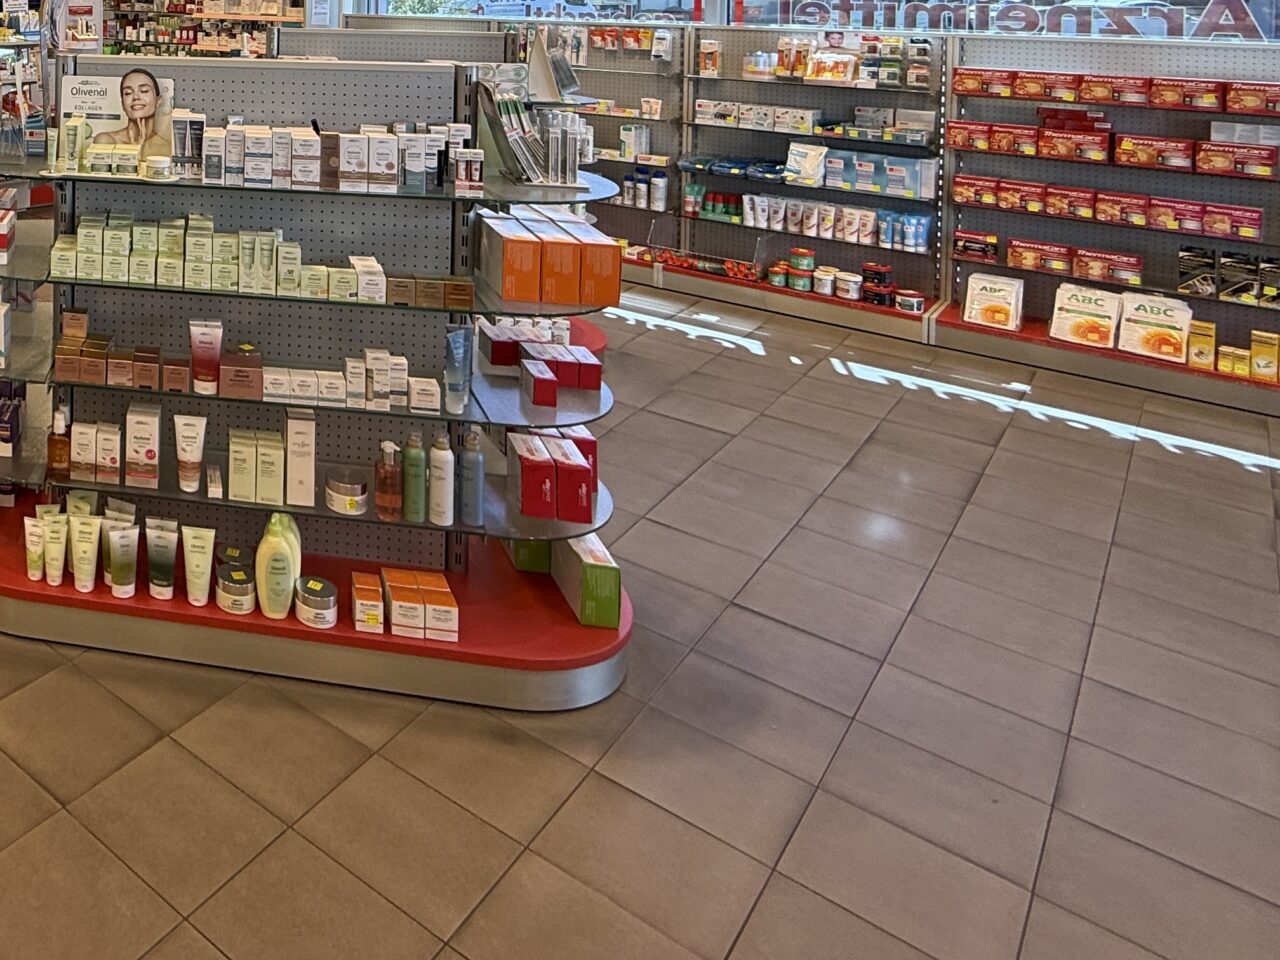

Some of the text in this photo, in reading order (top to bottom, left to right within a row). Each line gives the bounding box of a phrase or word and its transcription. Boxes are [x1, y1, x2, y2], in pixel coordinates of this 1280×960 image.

[70, 86, 108, 97] Olivenöl
[1231, 83, 1280, 93] ThermaC
[1201, 144, 1271, 155] ThermaCare
[1066, 293, 1105, 307] ABC
[1134, 303, 1176, 318] ABC
